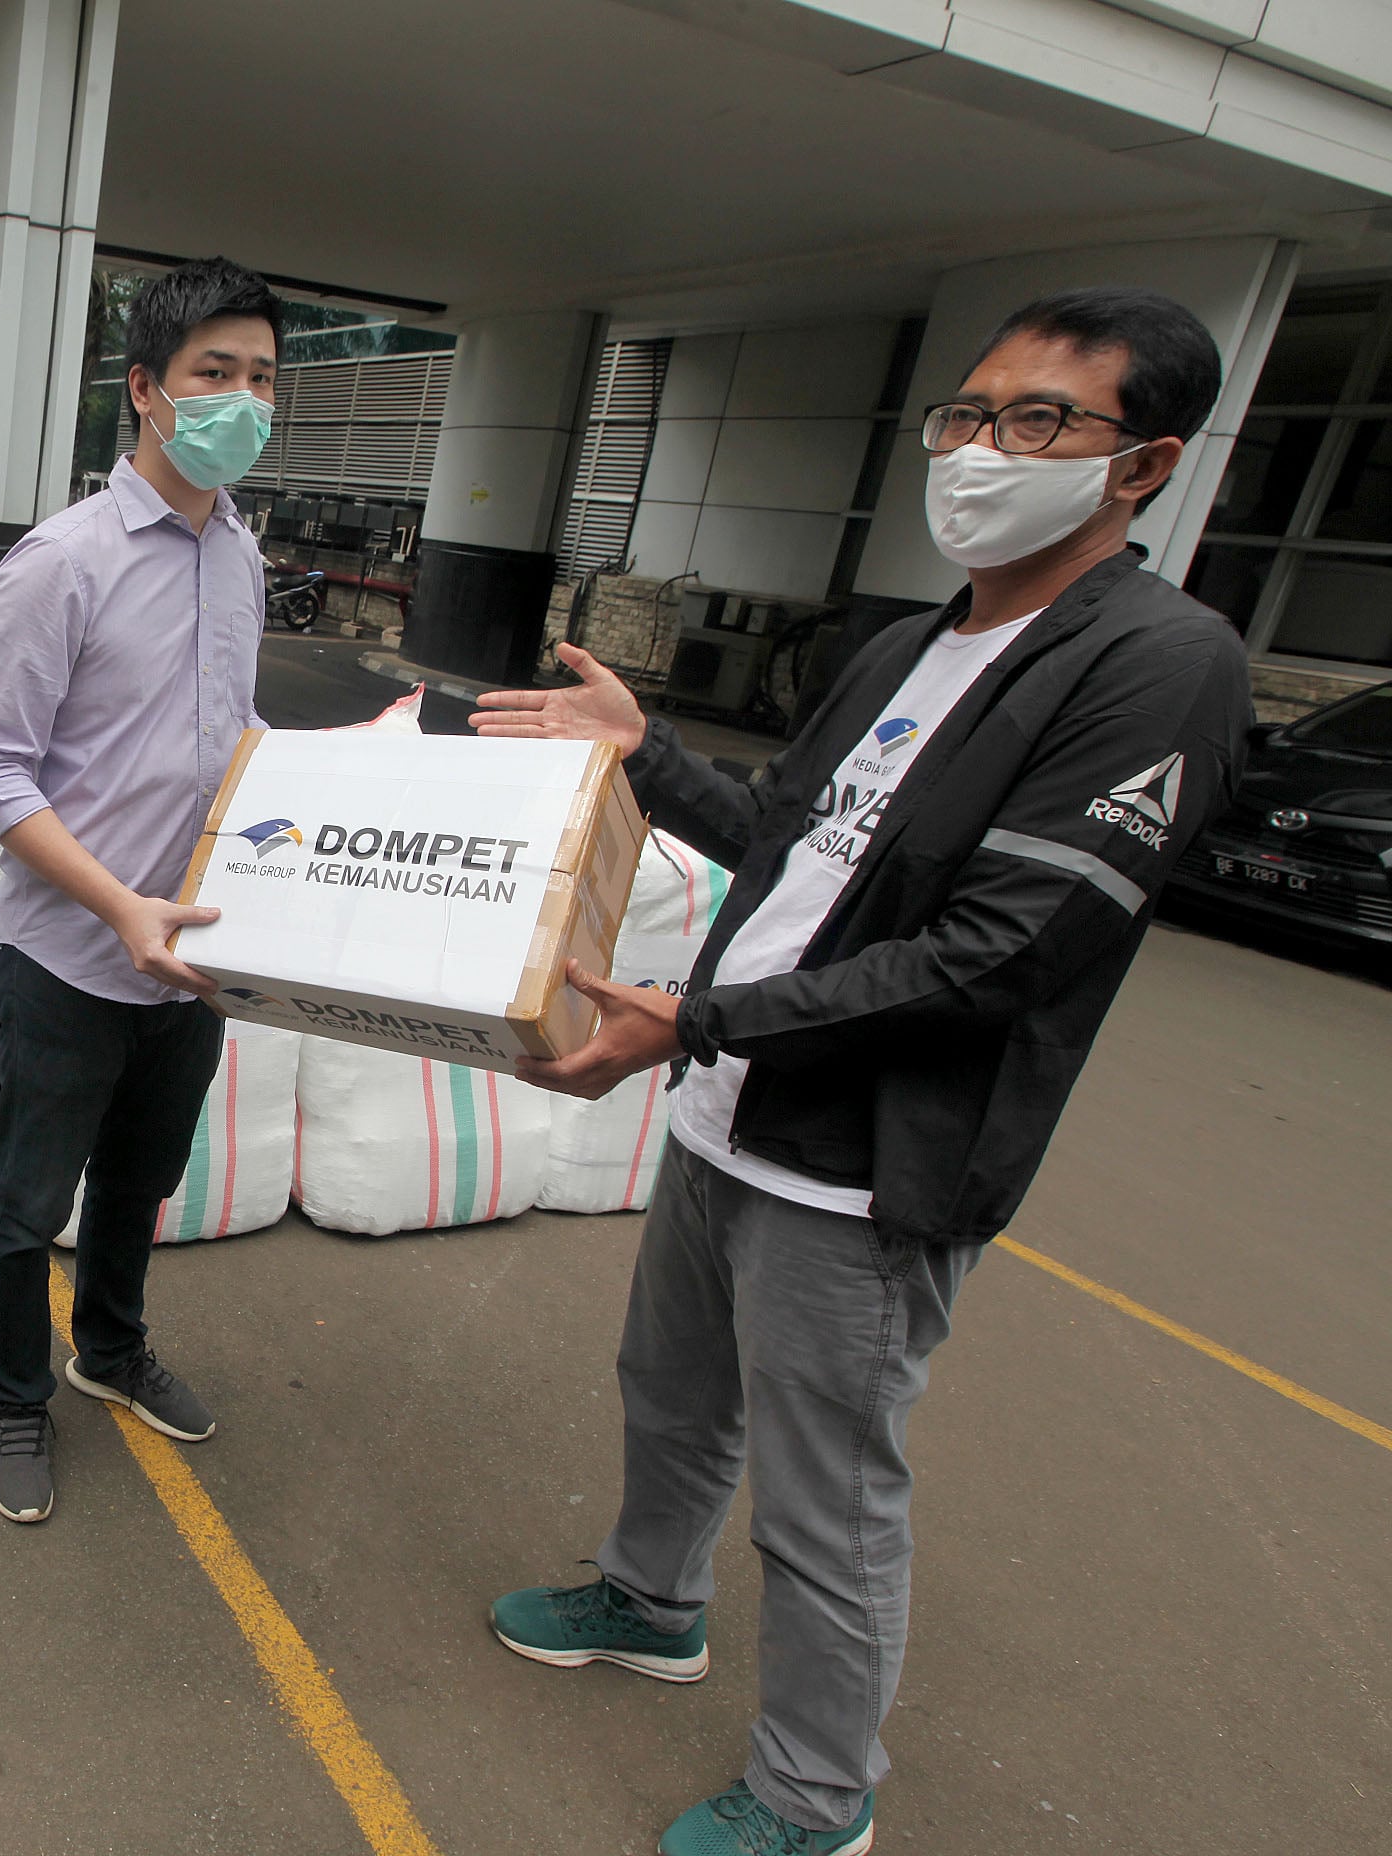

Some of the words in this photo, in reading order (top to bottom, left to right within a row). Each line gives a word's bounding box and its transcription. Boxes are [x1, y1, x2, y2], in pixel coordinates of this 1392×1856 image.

[853, 758, 879, 775] MEDIA
[1084, 797, 1169, 851] Reebok
[225, 861, 258, 876] MEDIA
[260, 865, 296, 879] GROUP
[313, 824, 529, 874] DOMPET
[305, 861, 517, 904] KEMANUSIAAN
[290, 997, 490, 1045] DOMPET
[306, 1015, 507, 1059] KEMANUSIAAN
